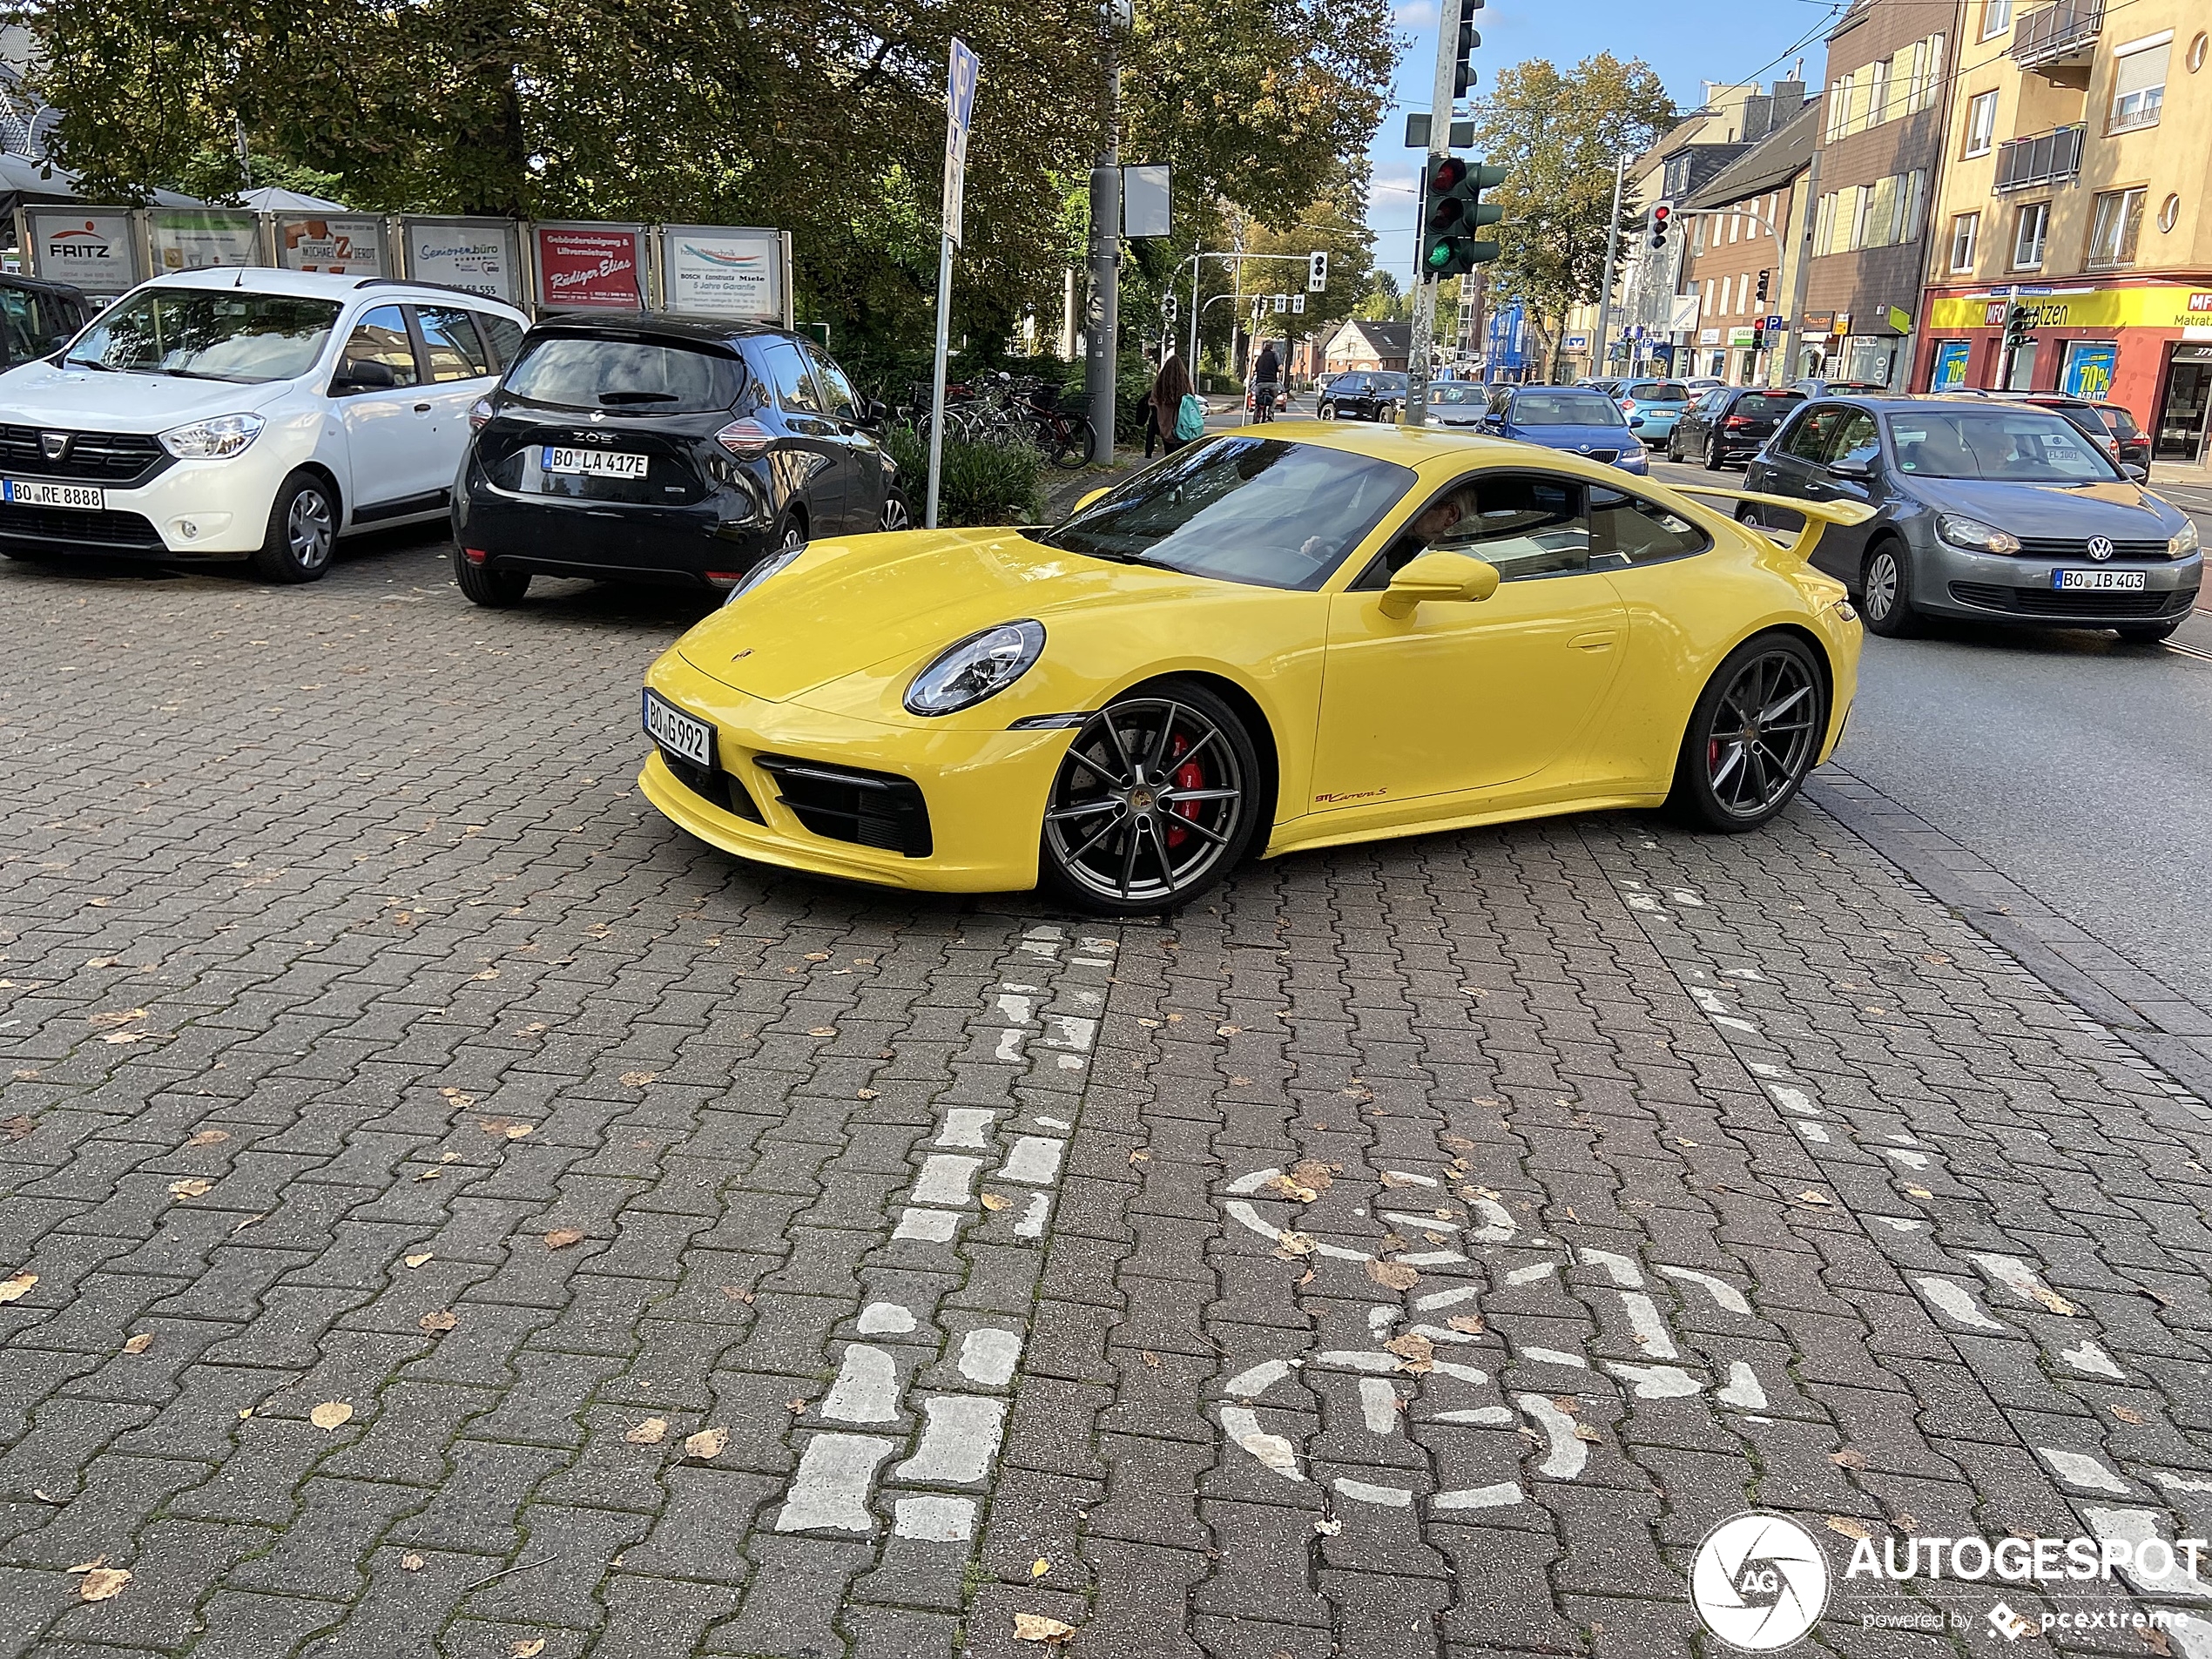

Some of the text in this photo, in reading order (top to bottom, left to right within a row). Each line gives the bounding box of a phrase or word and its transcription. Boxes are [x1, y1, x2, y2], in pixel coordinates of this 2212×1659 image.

[547, 235, 630, 247] Gebäudereinigung &
[50, 244, 110, 259] FRITZ
[301, 246, 336, 259] MICHAEL
[419, 244, 498, 260] Seniorenbüro
[550, 259, 632, 289] Rüdiger Elias
[480, 285, 496, 294] 555
[699, 281, 721, 290] Jahre
[723, 282, 756, 291] Garantie
[1986, 304, 2004, 324] MFO
[1769, 317, 1778, 329] P
[1645, 339, 1651, 348] P
[2080, 365, 2109, 393] 70%
[553, 449, 573, 467] BO
[583, 452, 602, 470] LA
[606, 454, 645, 474] 417E
[14, 483, 100, 506] BO RE 8888
[2063, 573, 2084, 587] BO
[2094, 573, 2114, 588] IB
[2116, 574, 2144, 588] 403
[651, 700, 703, 759] BO G 992
[1328, 792, 1375, 803] Carrera
[1376, 787, 1388, 796] S
